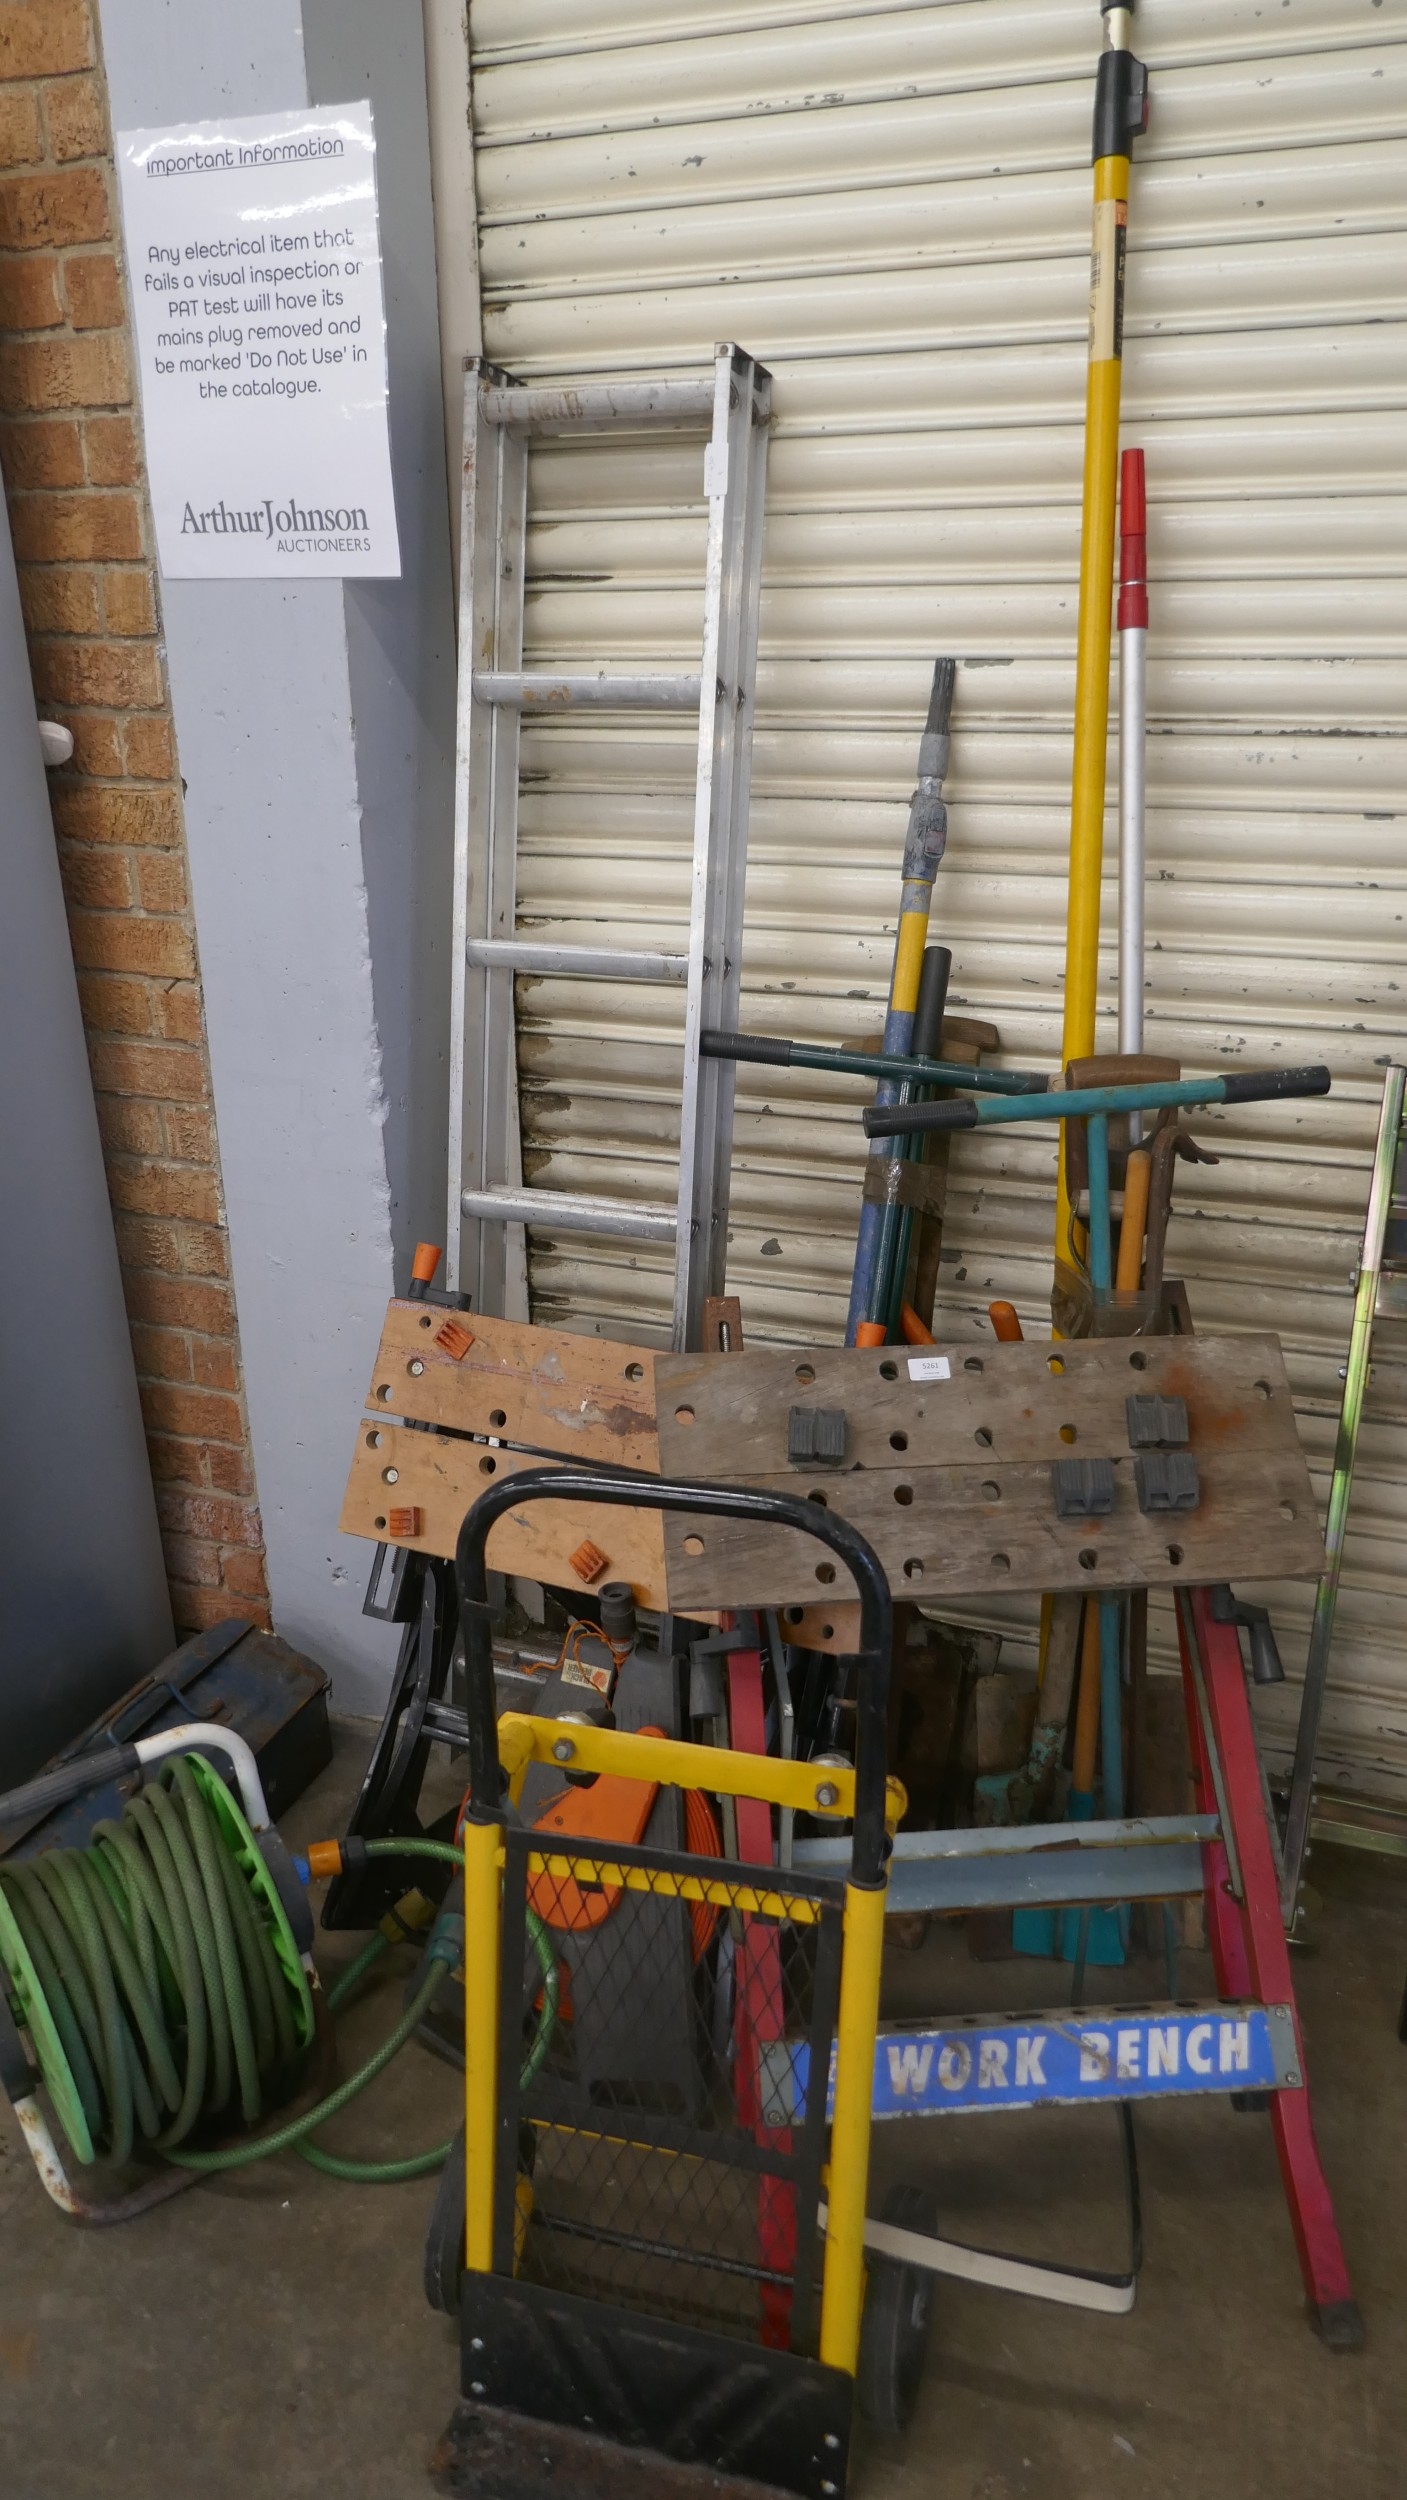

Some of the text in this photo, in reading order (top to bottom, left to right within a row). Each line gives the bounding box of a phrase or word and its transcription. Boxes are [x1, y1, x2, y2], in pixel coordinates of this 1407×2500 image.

[239, 137, 344, 164] Information
[149, 228, 354, 266] Any electrical item that
[144, 260, 361, 292] fails a visual inspection or
[168, 289, 344, 318] PAT test will have its
[157, 315, 361, 347] mains plug removed and
[155, 357, 175, 374] be
[179, 352, 241, 372] marked
[277, 349, 307, 366] Not
[352, 345, 367, 361] in
[199, 377, 321, 398] the catalogue.
[277, 538, 371, 552] AUCTIONEERS
[888, 2036, 1047, 2094] WORK
[1080, 2022, 1250, 2083] BENCH
